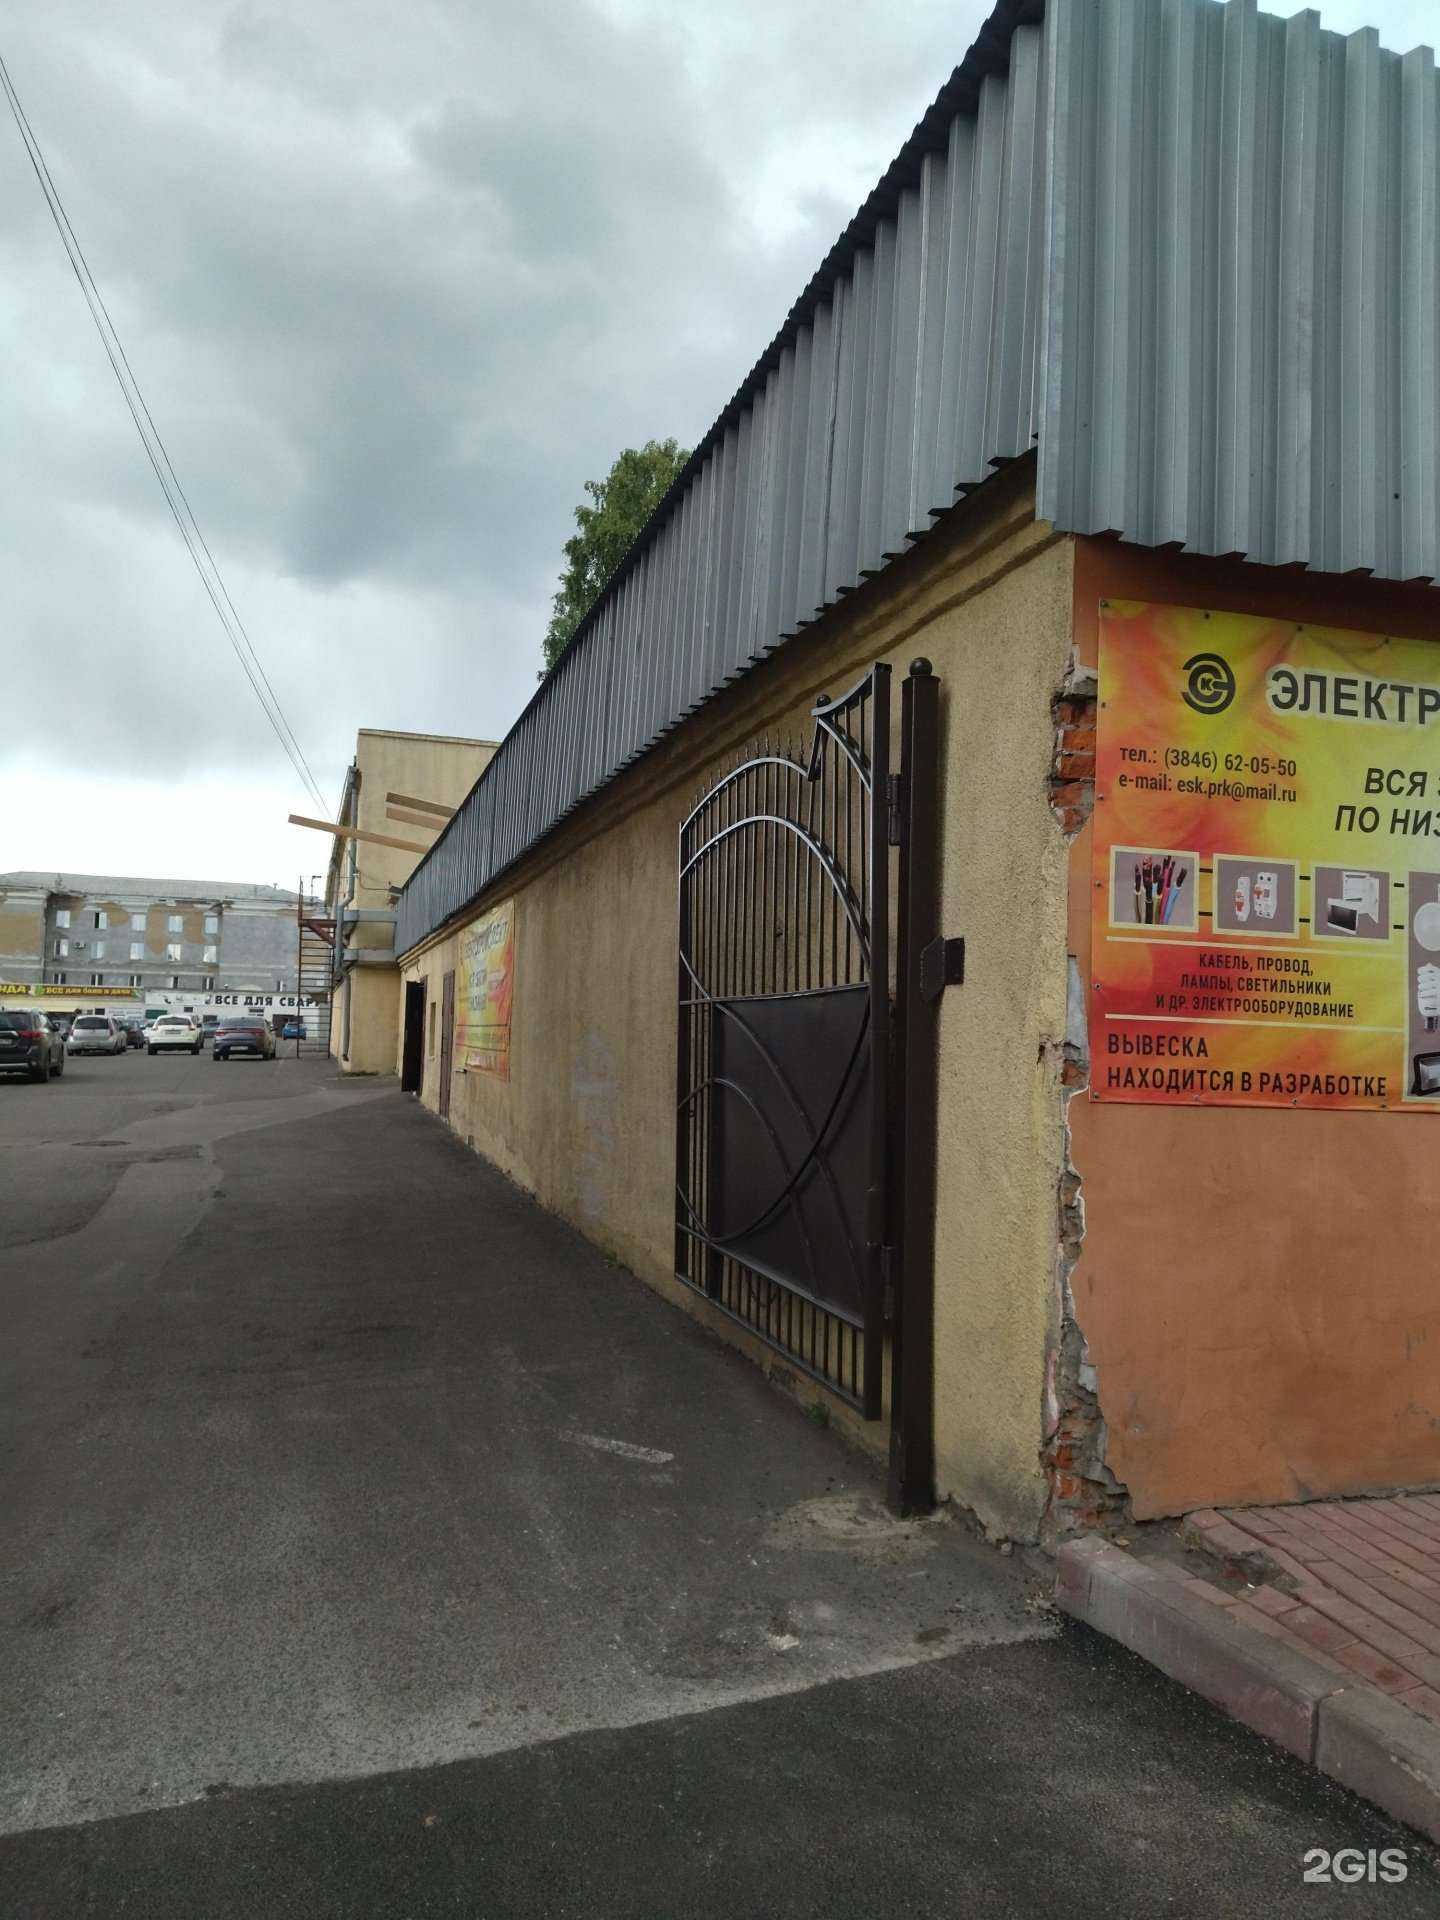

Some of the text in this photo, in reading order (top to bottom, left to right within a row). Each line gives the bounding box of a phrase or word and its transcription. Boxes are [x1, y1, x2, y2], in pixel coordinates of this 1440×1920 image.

[1119, 746, 1297, 777] тел.: (3846) 62-05-50
[1118, 772, 1297, 802] e-mail: esk.prk@mail.ru
[1364, 767, 1427, 797] ВСЯ
[1334, 804, 1380, 833] ПО
[1199, 953, 1314, 976] КАБЕЛЬ, ПРОВОД,
[1180, 973, 1331, 996] ЛАМПЫ, СВЕТИЛЬНИКИ
[215, 995, 238, 1005] ВСЕ
[244, 996, 273, 1006] ДЛЯ
[1156, 996, 1354, 1018] И ДР. ЭЛЕКТРООБОРУДОВАНИЕ
[1107, 1033, 1209, 1058] ВЫВЕСКА
[1107, 1066, 1387, 1097] НАХОДИТСЯ В РАЗРАБОТКЕ
